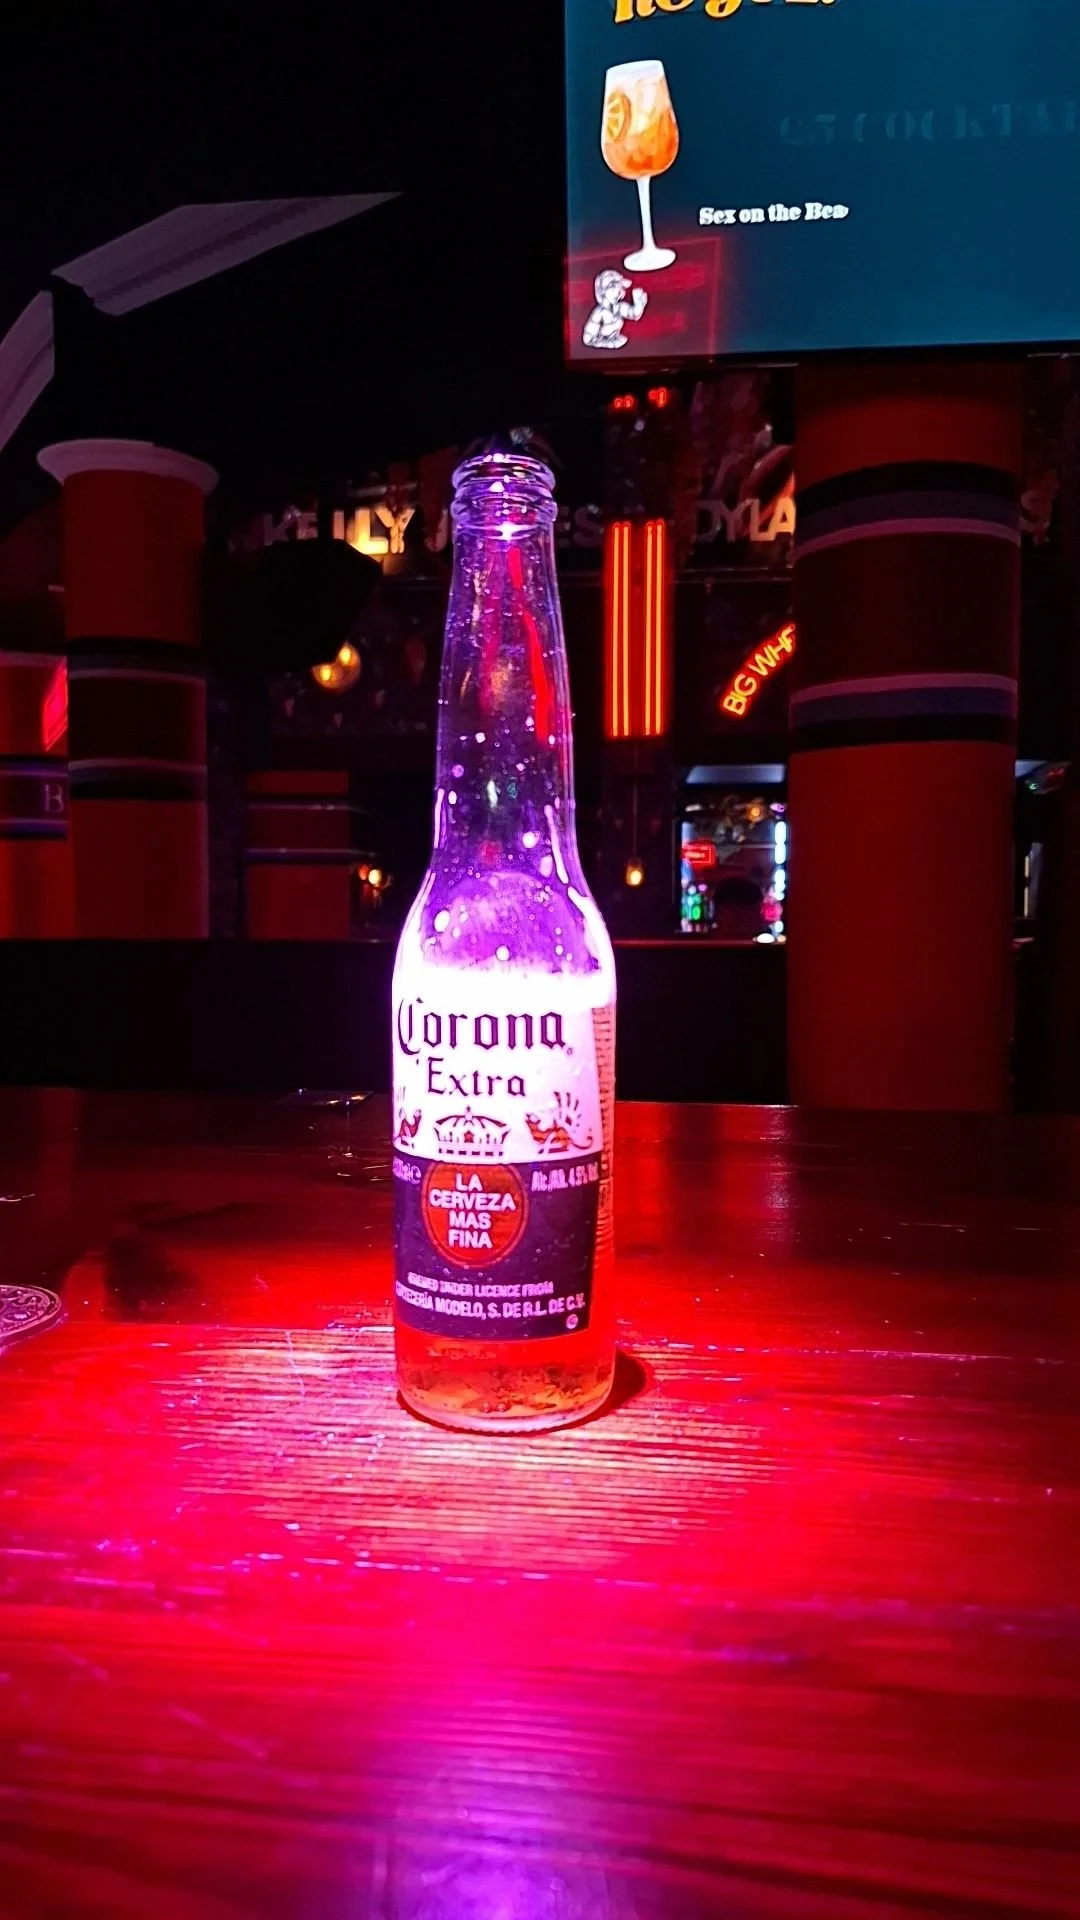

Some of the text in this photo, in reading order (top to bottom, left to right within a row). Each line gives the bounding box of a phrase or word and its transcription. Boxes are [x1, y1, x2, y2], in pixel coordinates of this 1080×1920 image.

[699, 206, 737, 225] Sex
[739, 207, 765, 223] on
[768, 203, 802, 222] the
[722, 673, 757, 715] BIG
[397, 997, 567, 1055] Corona
[427, 1056, 526, 1097] Extra
[454, 1172, 482, 1191] LA
[428, 1188, 516, 1211] CERVEZA
[449, 1210, 492, 1230] MAS
[448, 1229, 493, 1249] FINA
[439, 1280, 473, 1297] UNDER
[474, 1283, 521, 1298] LICENCE
[521, 1280, 554, 1298] FROM
[487, 1301, 501, 1319] S.
[502, 1301, 521, 1319] DE
[548, 1296, 565, 1315] DE
